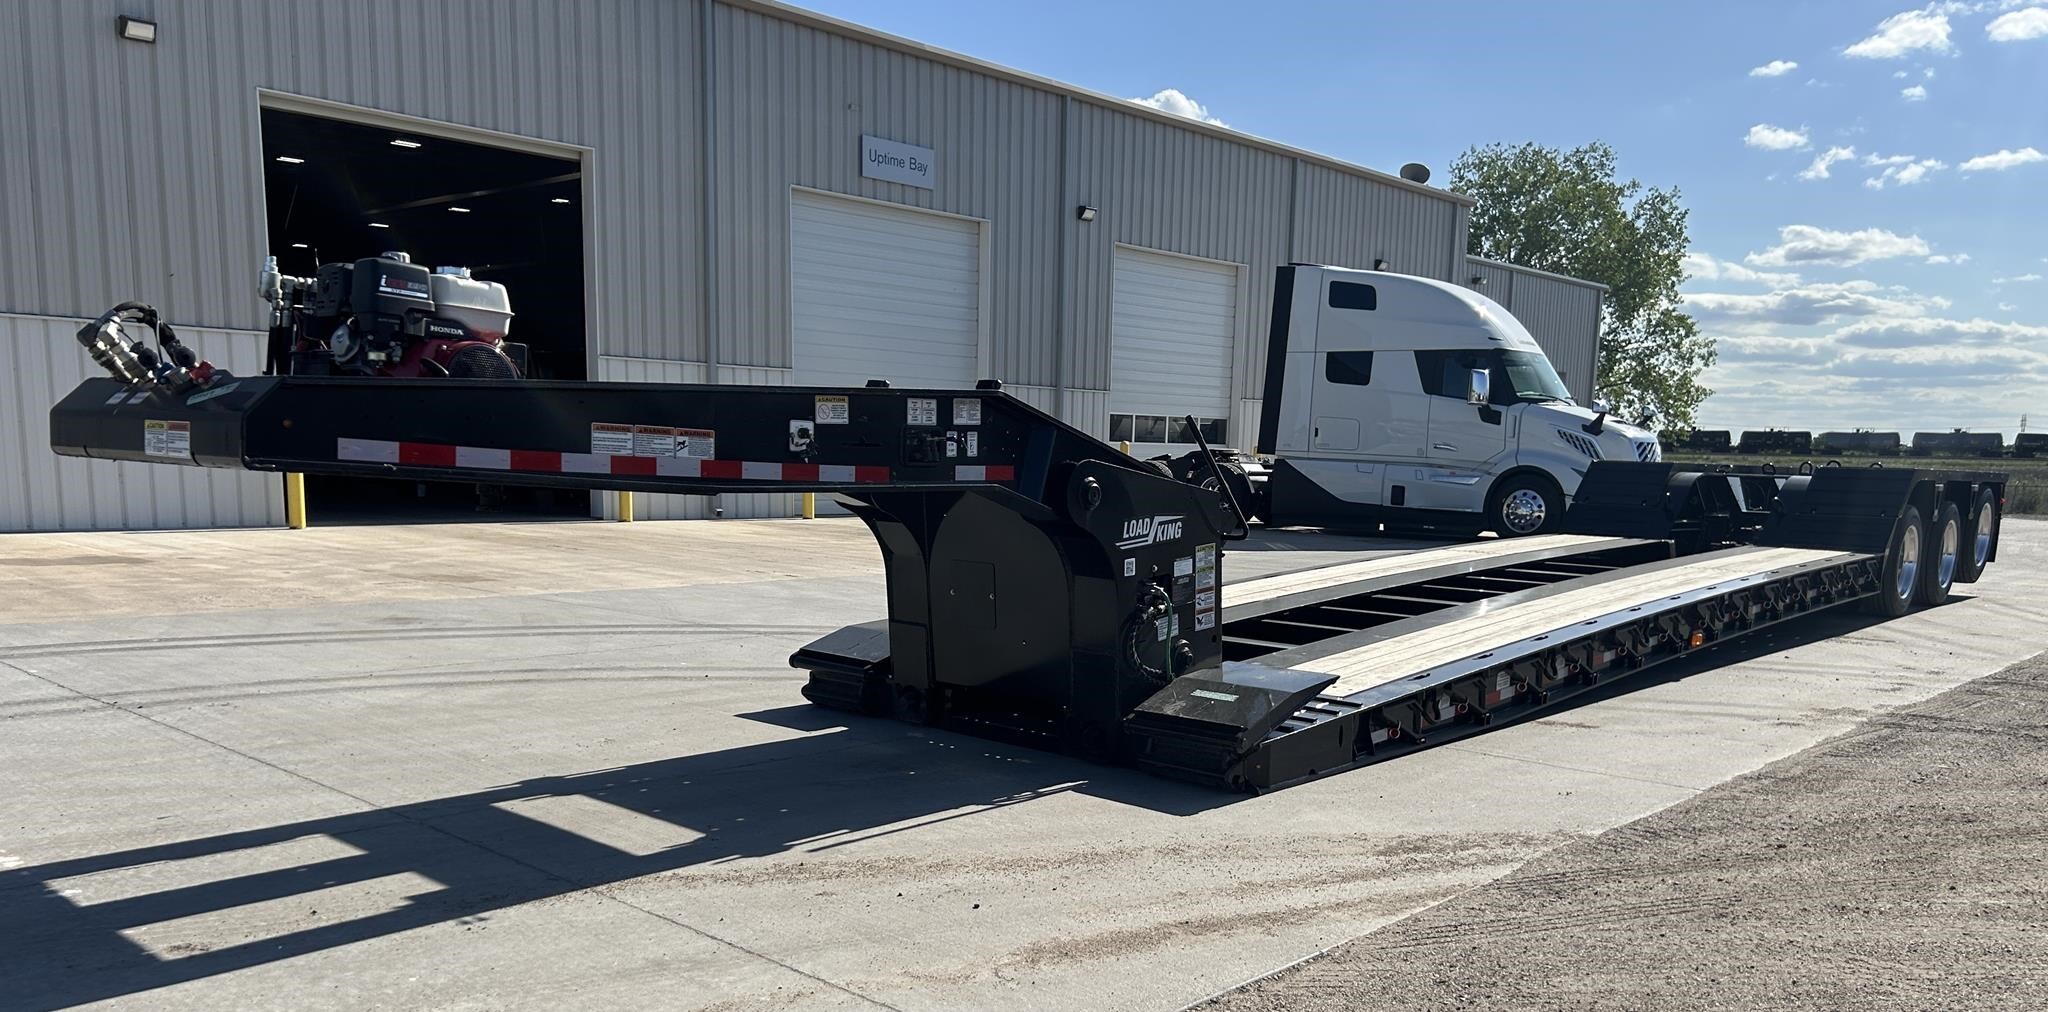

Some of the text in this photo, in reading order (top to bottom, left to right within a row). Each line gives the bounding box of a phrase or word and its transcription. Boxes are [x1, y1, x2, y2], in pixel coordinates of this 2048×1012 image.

[869, 148, 928, 176] Uptime Bay
[430, 325, 464, 336] HONDA
[1123, 518, 1182, 542] LOAD KING
